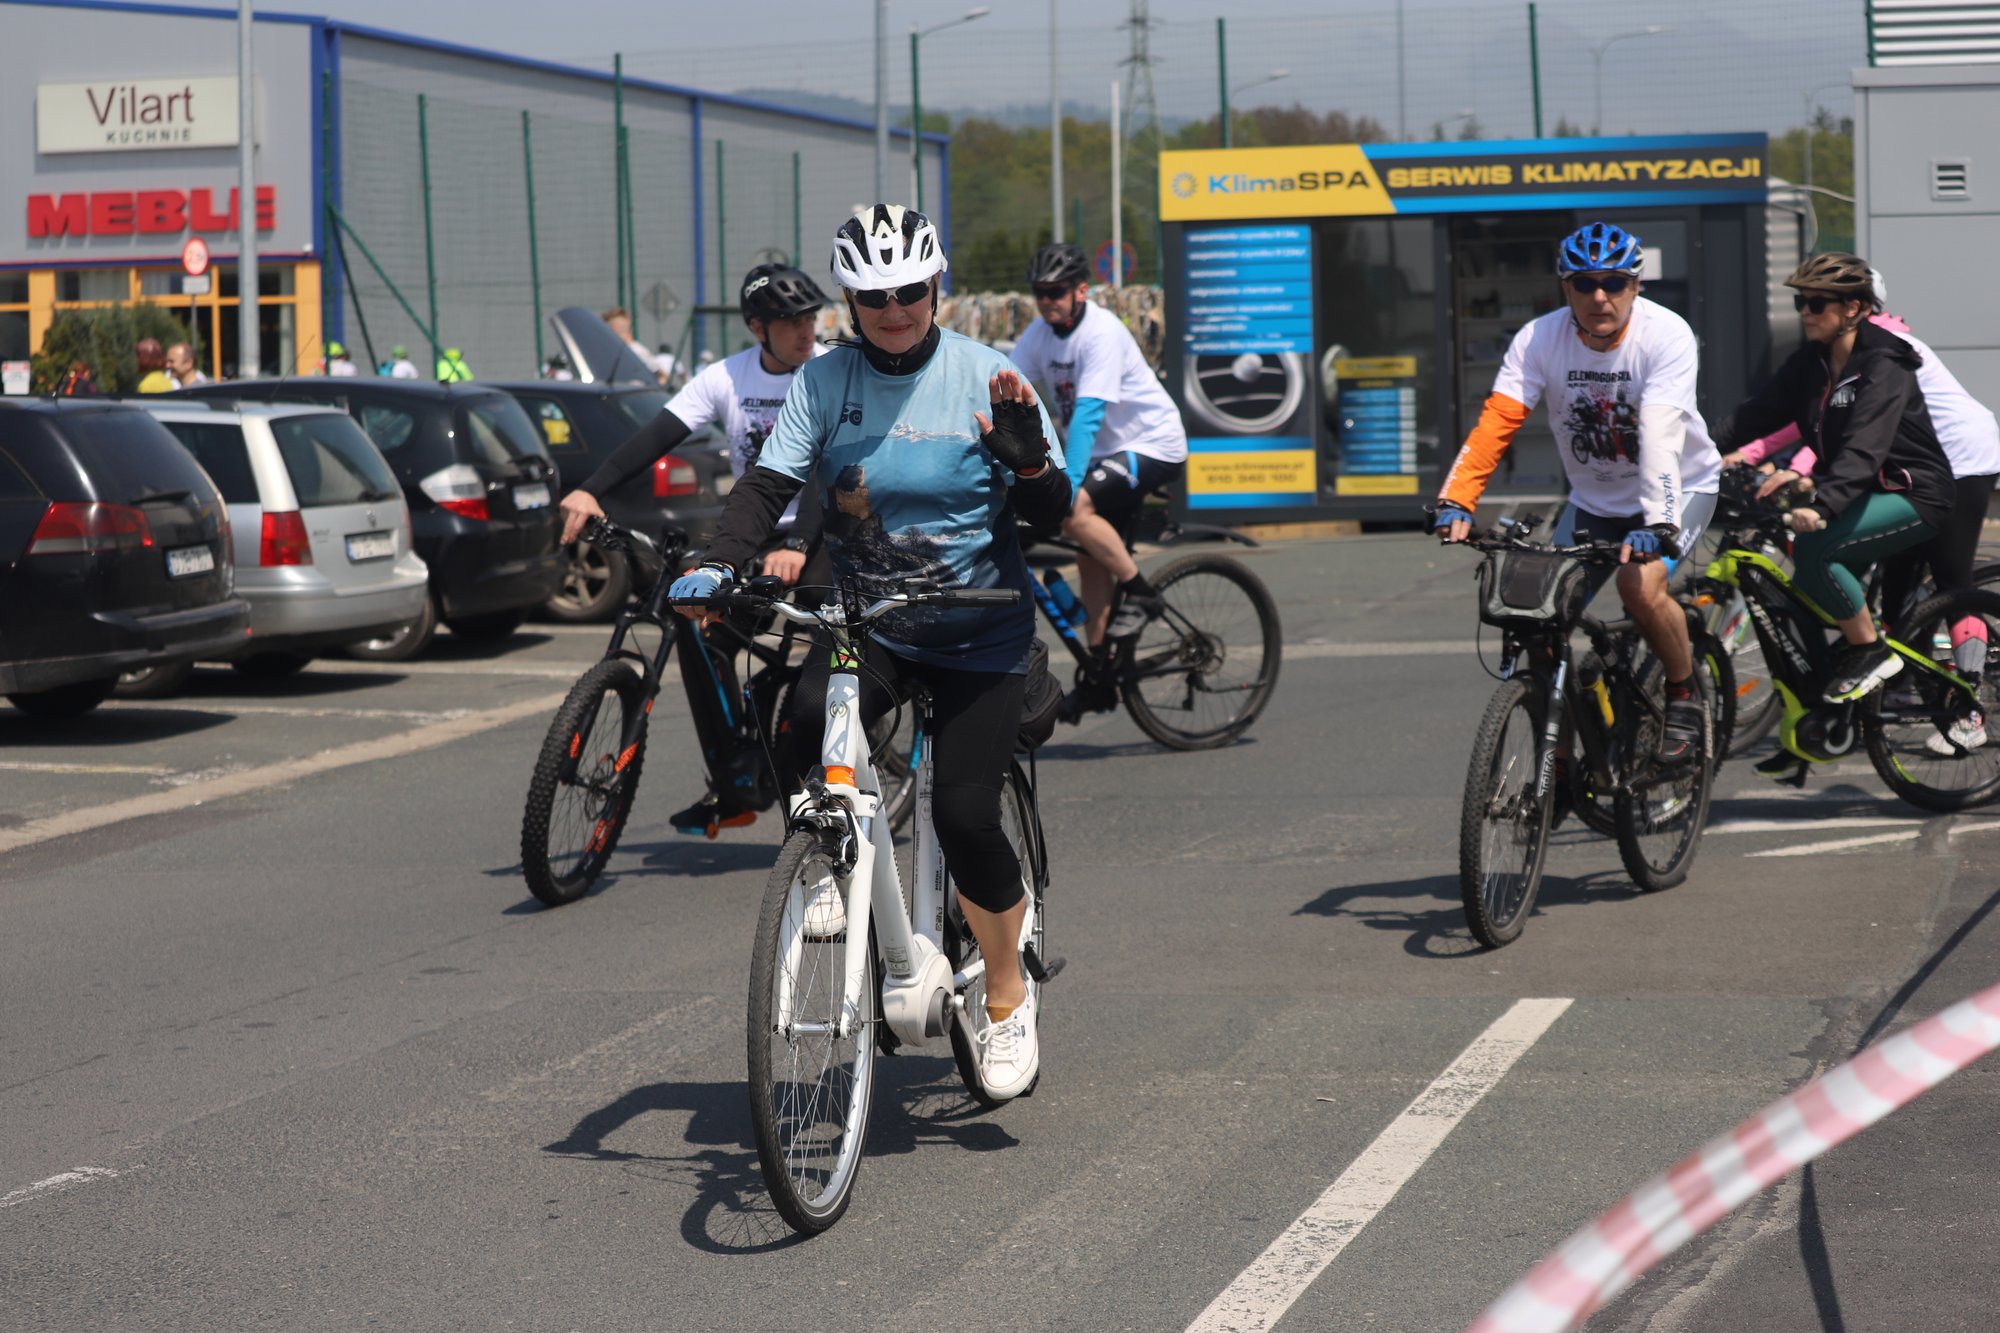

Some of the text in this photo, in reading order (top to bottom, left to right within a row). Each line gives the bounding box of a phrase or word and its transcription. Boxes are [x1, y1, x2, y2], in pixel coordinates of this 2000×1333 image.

[87, 85, 194, 125] Vilart
[106, 128, 192, 143] KUCHNIE
[1208, 171, 1369, 193] KlimaSPA
[1387, 158, 1761, 188] SERWIS KLIMATYZACJI
[27, 185, 275, 237] MEBLE
